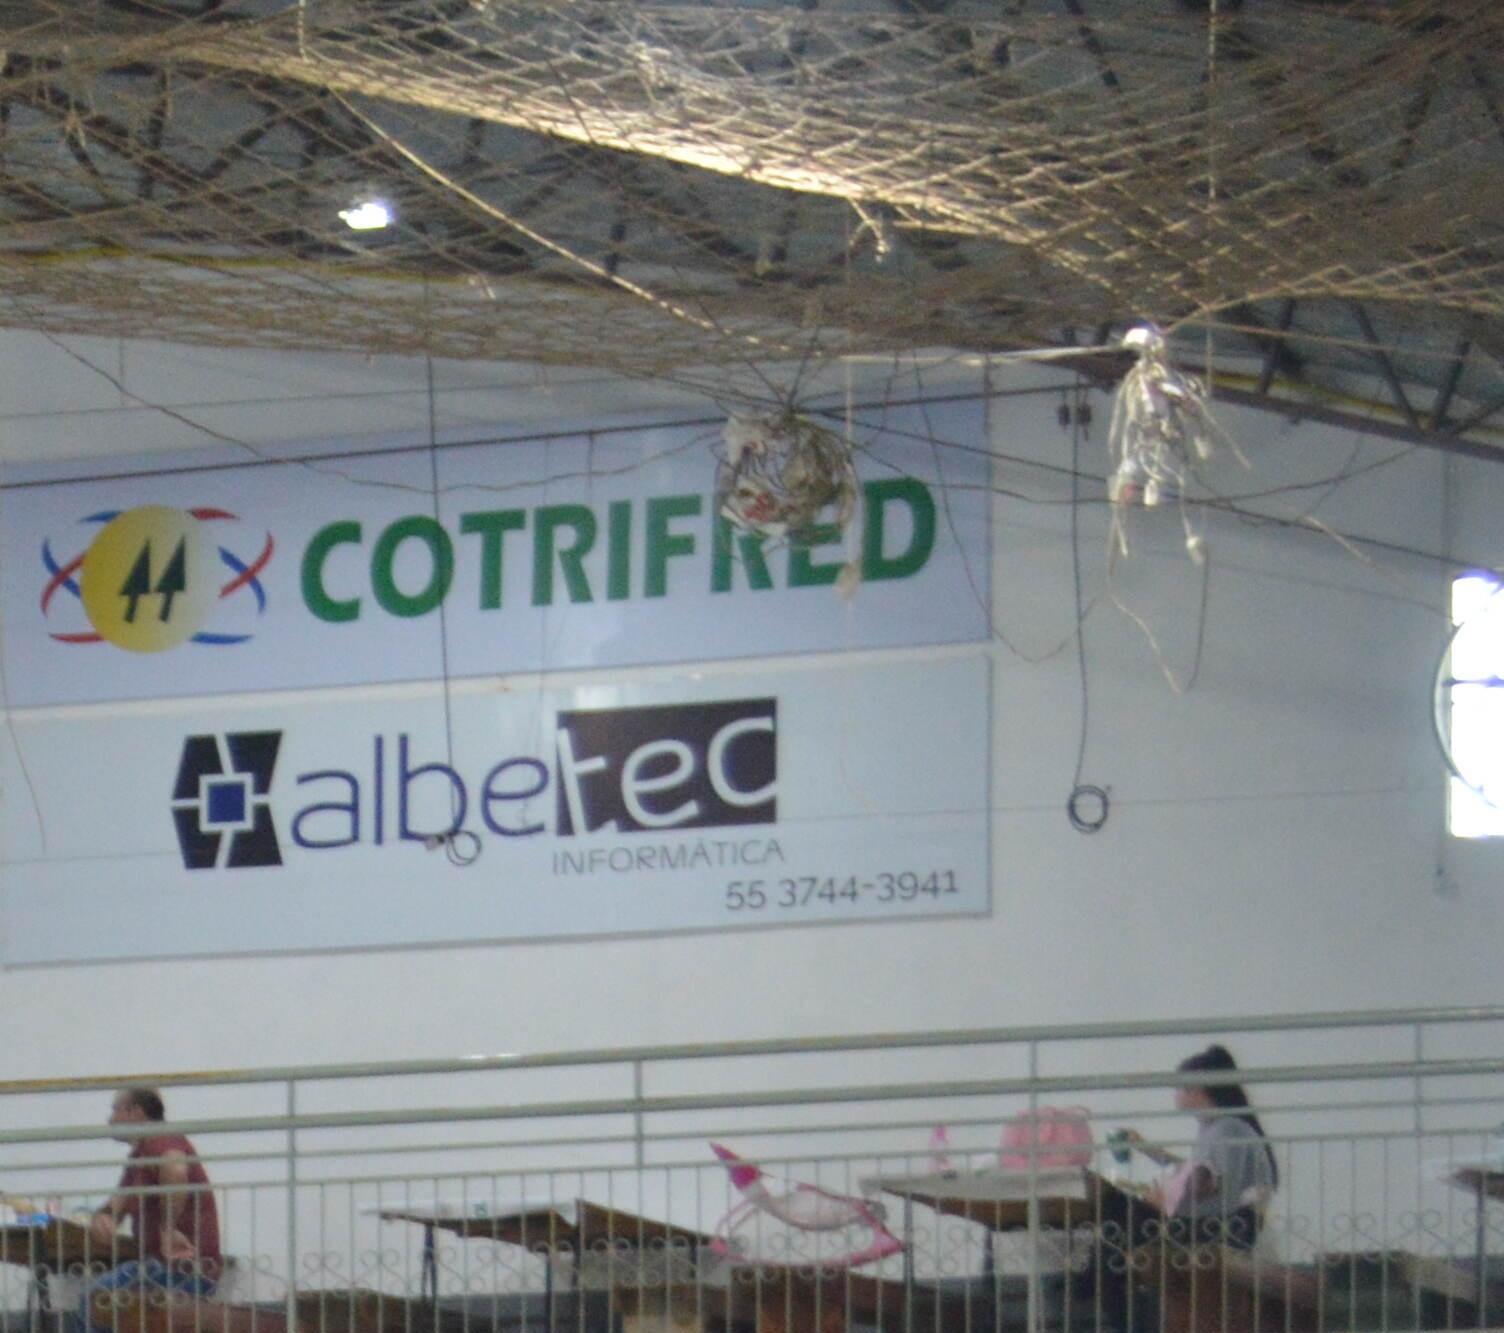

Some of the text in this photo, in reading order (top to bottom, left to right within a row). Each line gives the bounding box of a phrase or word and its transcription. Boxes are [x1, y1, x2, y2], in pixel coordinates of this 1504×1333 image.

[288, 712, 778, 851] albetec
[551, 837, 786, 877] INFORMÁTICA
[725, 869, 959, 911] 55 3744-3941
